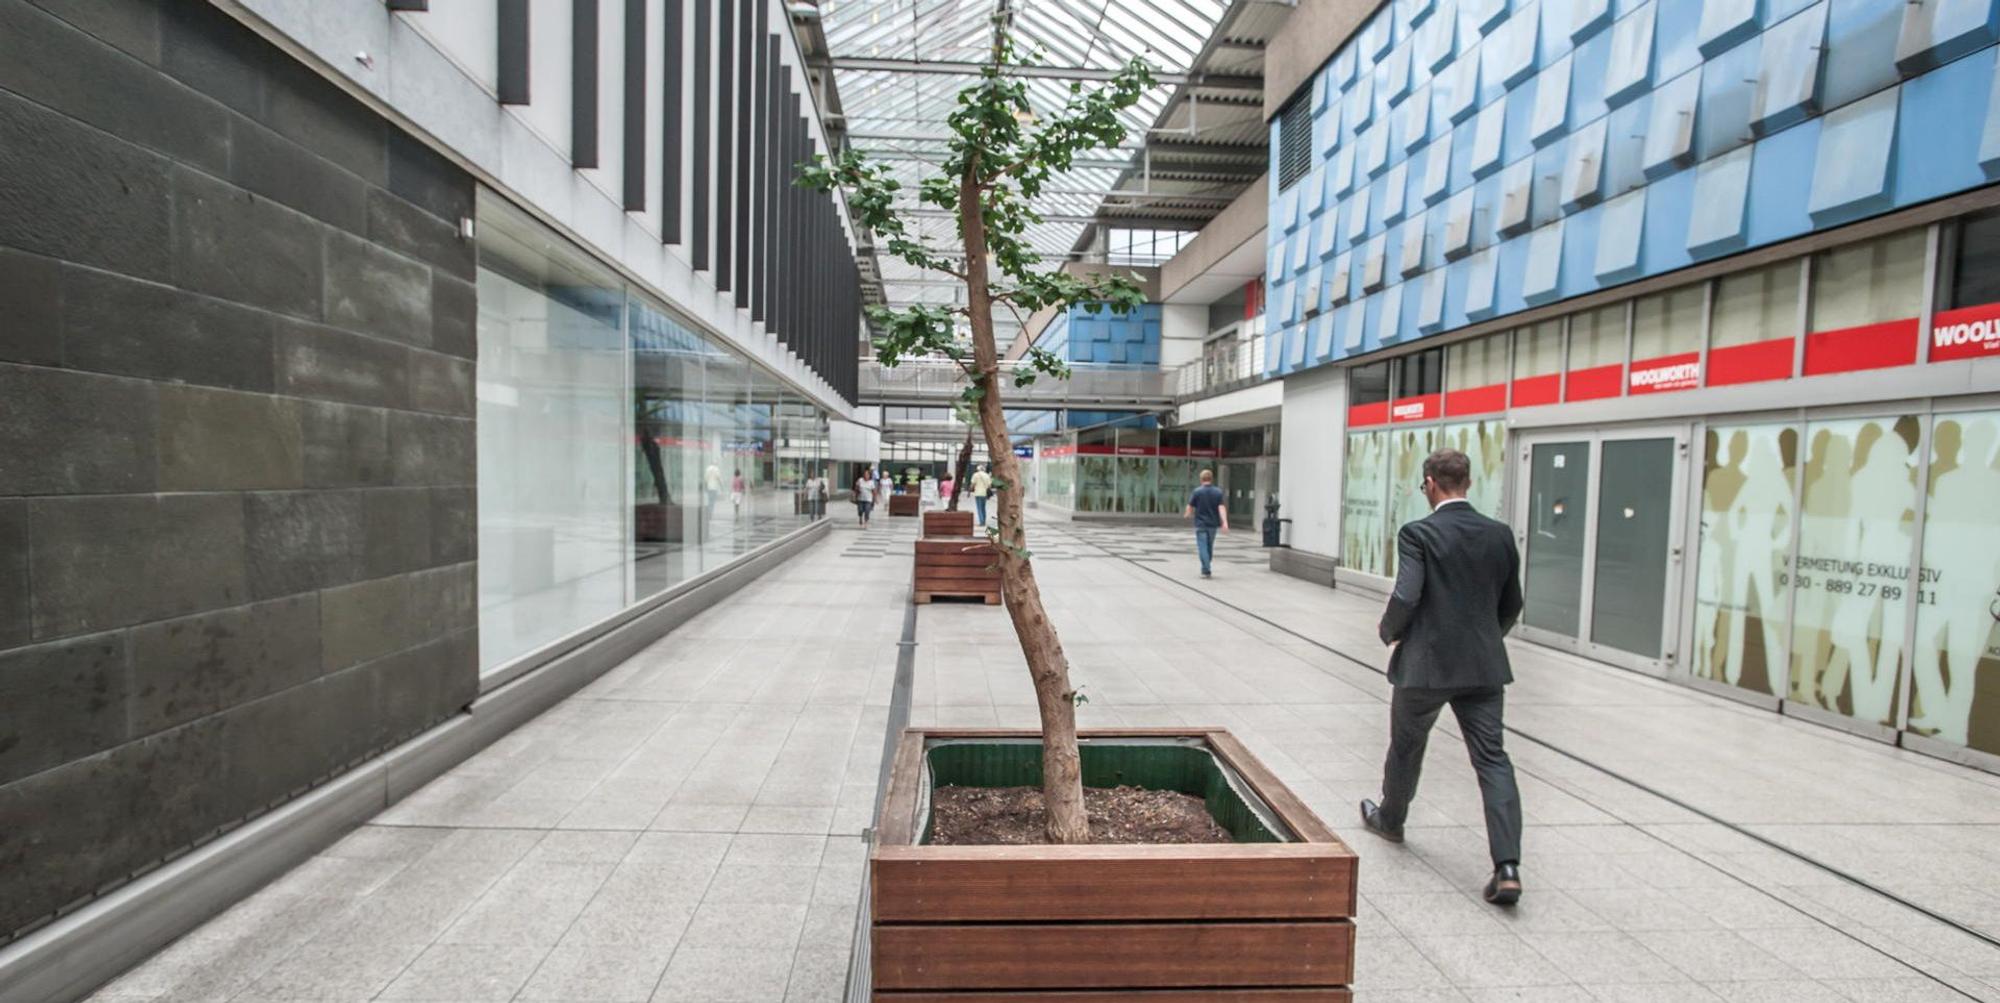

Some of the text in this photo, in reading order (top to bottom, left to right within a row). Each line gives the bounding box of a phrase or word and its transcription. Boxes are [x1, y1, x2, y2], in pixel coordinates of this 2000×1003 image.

[1630, 362, 1700, 386] WOOLWORTH
[1826, 578, 1852, 594] 889
[1857, 582, 1877, 597] 27
[1881, 585, 1902, 600] 89
